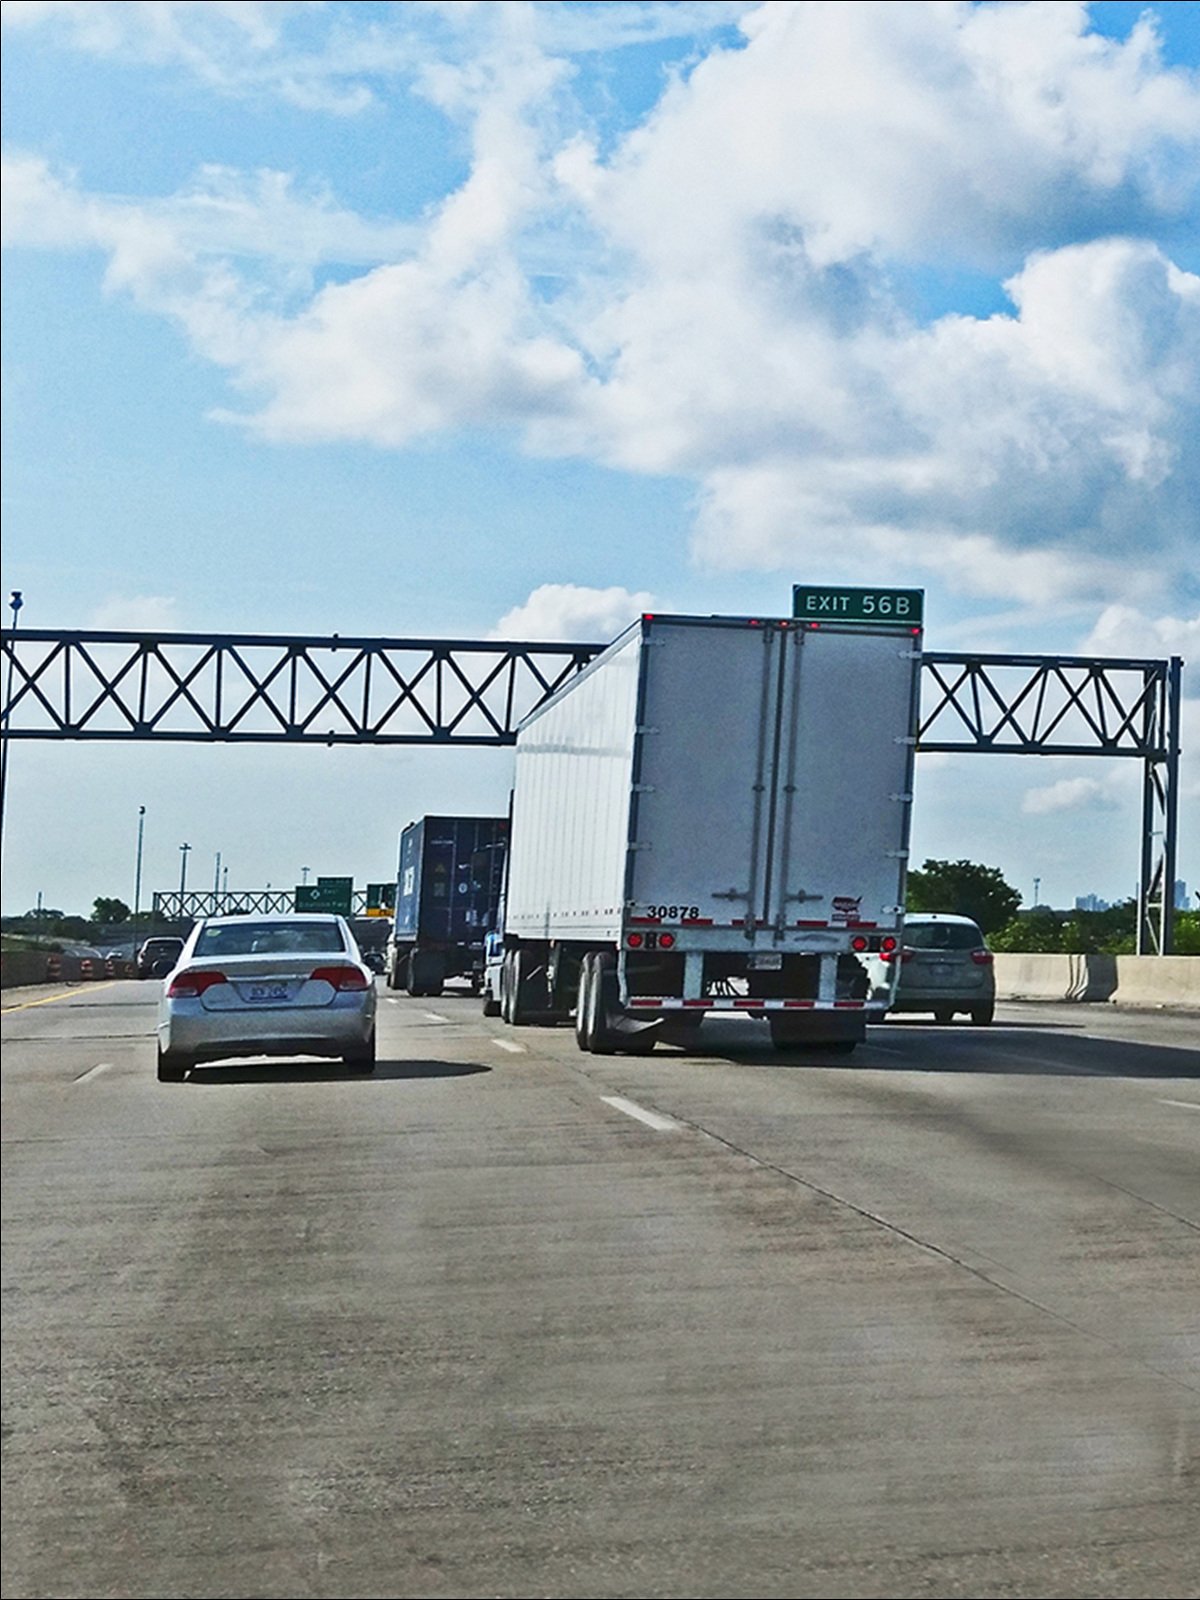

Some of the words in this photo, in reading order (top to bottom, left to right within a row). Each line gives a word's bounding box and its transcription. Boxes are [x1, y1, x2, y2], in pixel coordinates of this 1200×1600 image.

[806, 595, 850, 611] EXIT
[862, 595, 910, 615] 56B
[647, 905, 700, 919] 30878
